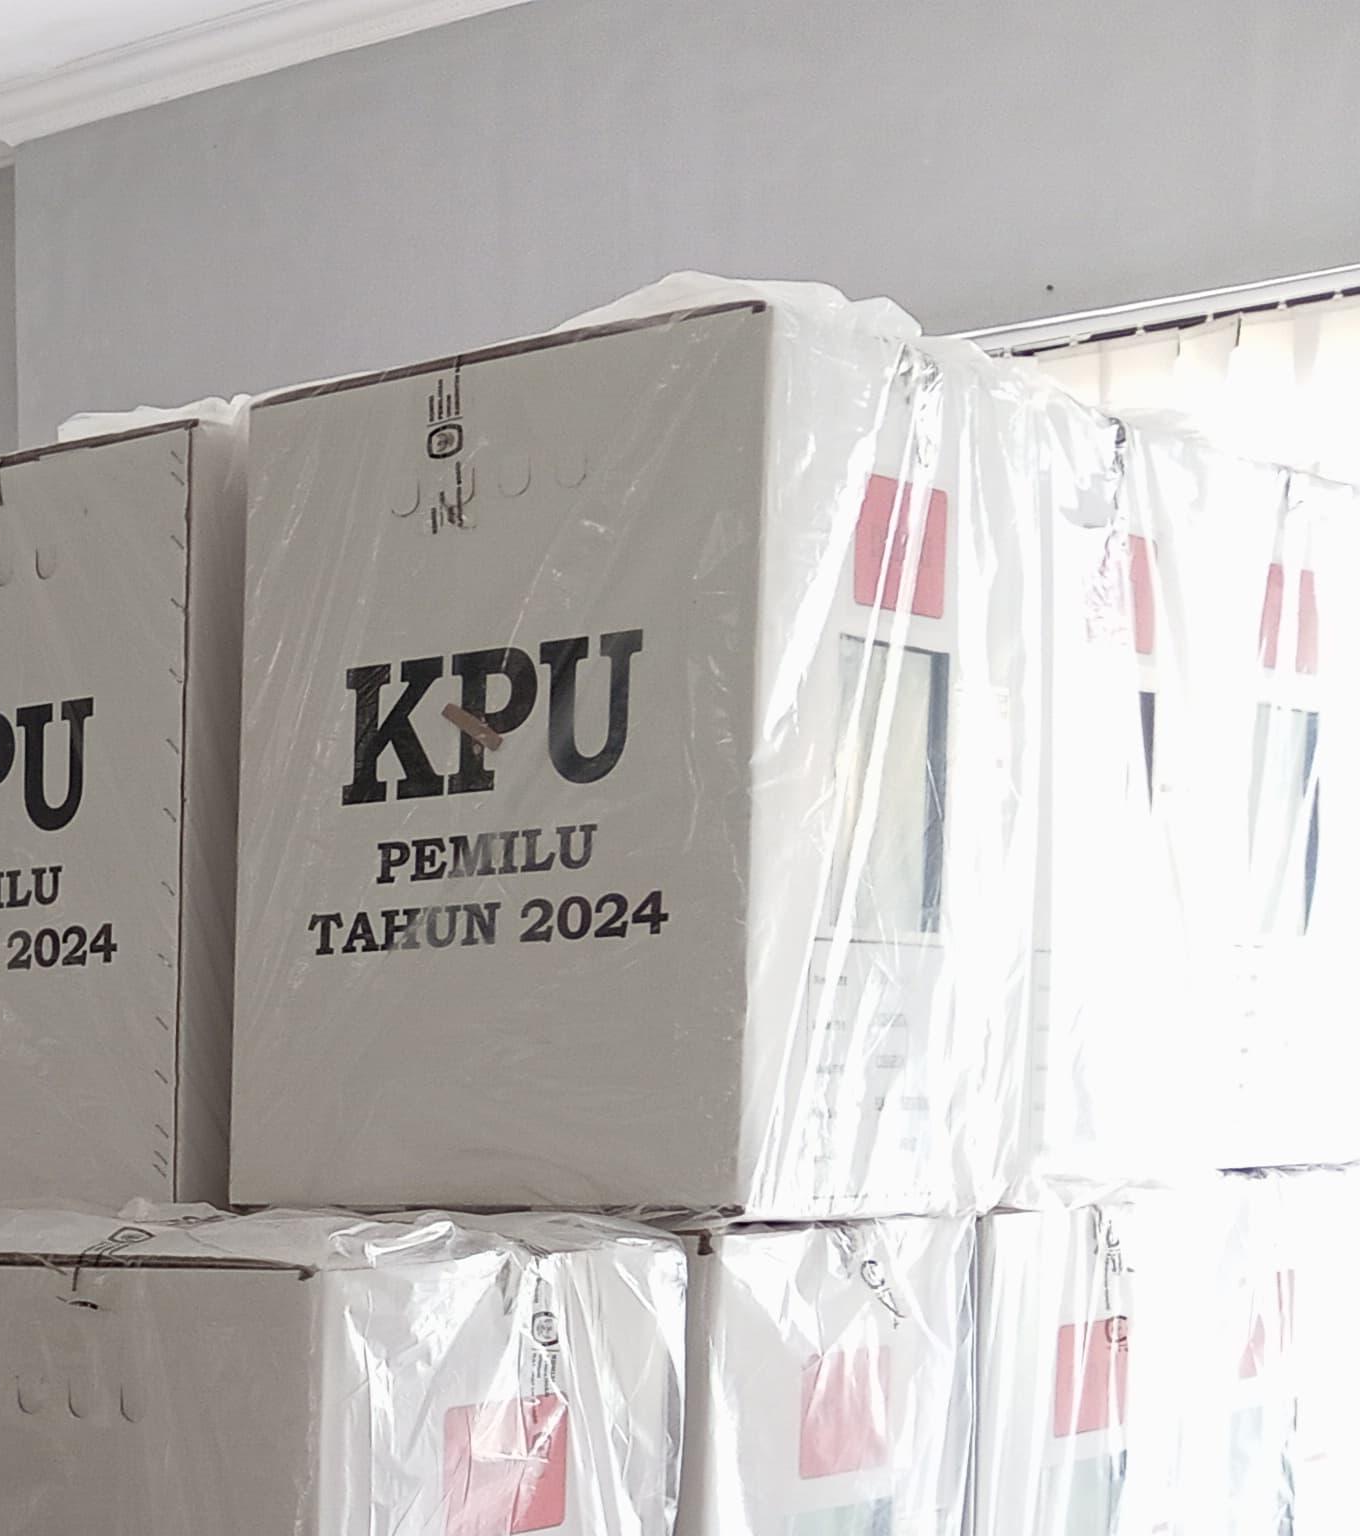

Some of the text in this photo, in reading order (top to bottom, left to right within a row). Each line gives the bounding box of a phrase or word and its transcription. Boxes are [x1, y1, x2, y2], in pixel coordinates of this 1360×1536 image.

[342, 628, 644, 806] KPU
[375, 823, 598, 885] PEMILU
[6, 924, 118, 970] 2024
[307, 891, 669, 957] TAHUN 2024
